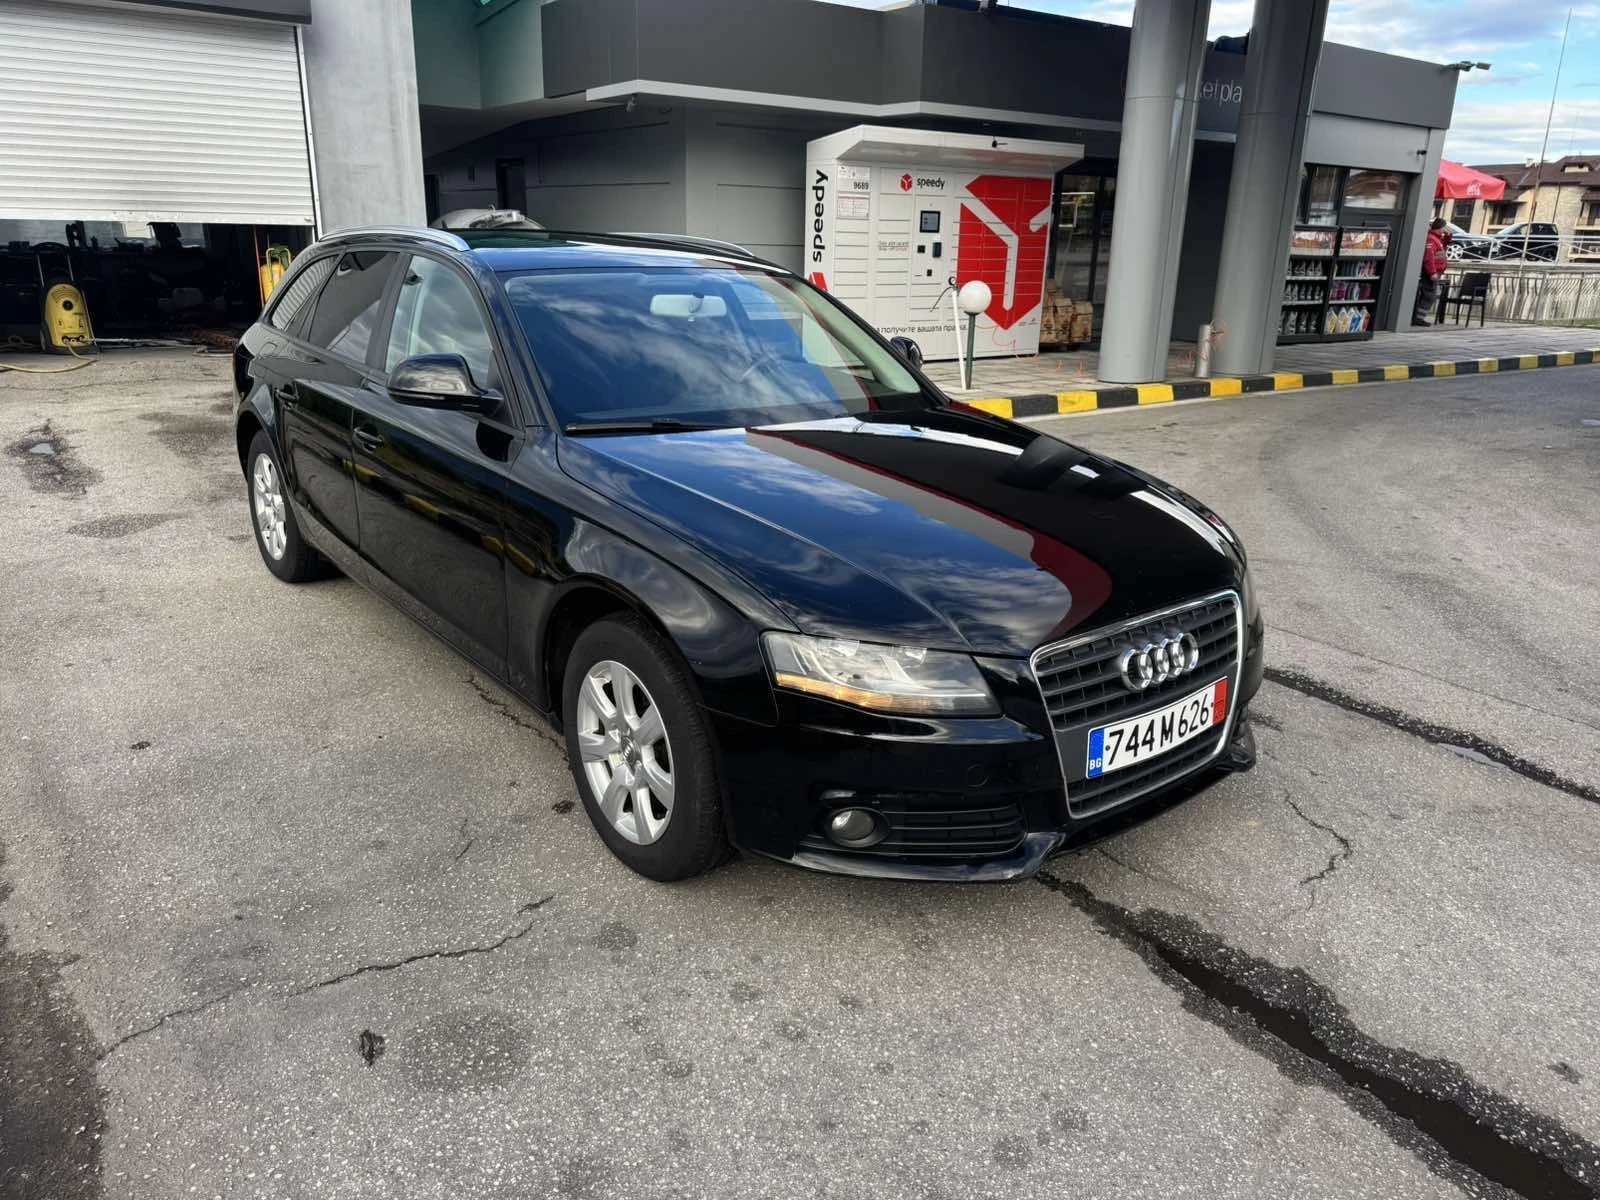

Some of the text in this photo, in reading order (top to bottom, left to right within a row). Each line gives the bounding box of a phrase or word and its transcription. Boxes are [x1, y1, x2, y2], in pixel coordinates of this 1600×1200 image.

[916, 177, 945, 190] speedy
[812, 169, 828, 262] speedy
[1089, 758, 1102, 770] BG
